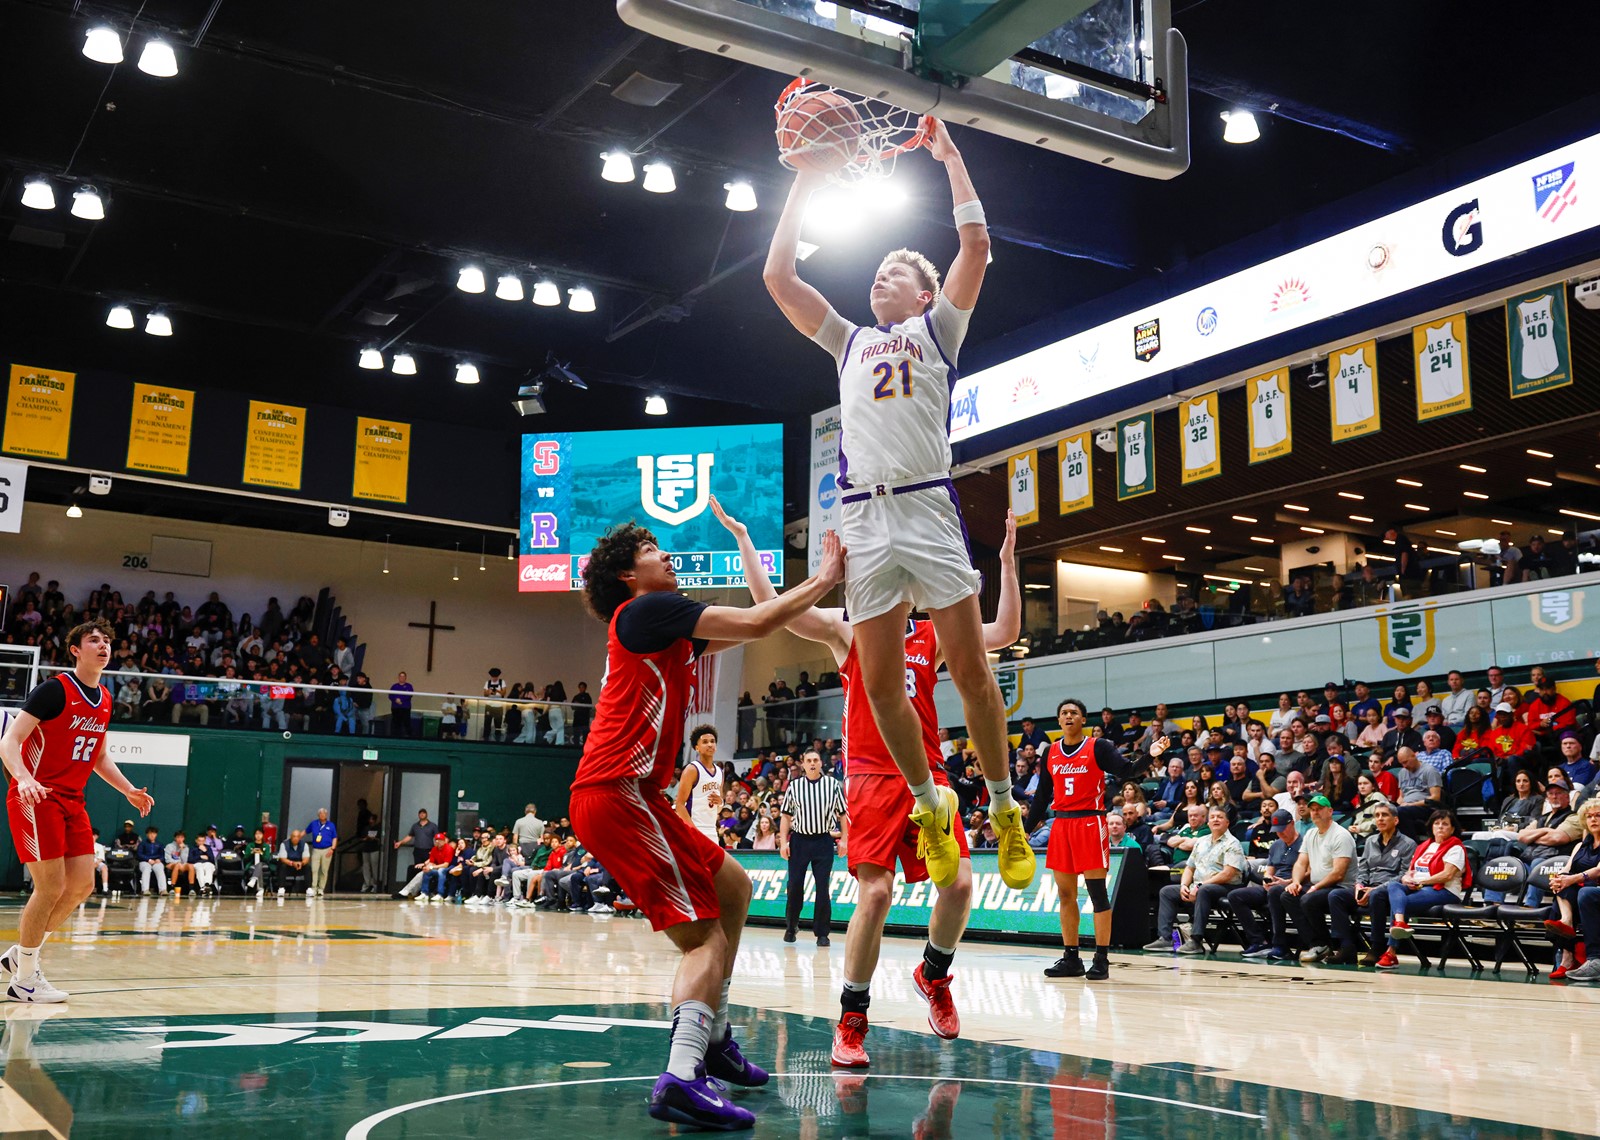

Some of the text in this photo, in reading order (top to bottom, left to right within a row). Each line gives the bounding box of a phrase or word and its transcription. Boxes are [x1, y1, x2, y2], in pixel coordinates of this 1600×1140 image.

[1442, 198, 1483, 257] G
[1525, 310, 1549, 325] U.S.F.
[1136, 325, 1158, 340] ARMY
[1527, 322, 1547, 340] 40
[1428, 338, 1454, 354] U.S.F.
[1430, 352, 1452, 373] 24
[1341, 364, 1365, 379] U.S.F.
[19, 376, 65, 391] FRANCISCO
[873, 359, 913, 402] 21
[1348, 378, 1358, 394] 4
[21, 395, 59, 406] NATIONAL
[142, 395, 185, 409] FRANCISCO
[1258, 389, 1279, 404] U.S.F.
[16, 403, 62, 413] CHAMPIONS
[1265, 404, 1273, 419] 6
[137, 418, 186, 430] TOURNAMENT
[257, 412, 297, 425] FRANCISCO
[1189, 414, 1209, 427] U.S.F.
[253, 429, 298, 440] CONFERENCE
[365, 428, 403, 441] FRANCISCO
[815, 419, 842, 439] FRANCISC
[1191, 426, 1208, 443] 32
[255, 436, 296, 446] CHAMPIONS
[1127, 432, 1143, 443] U.S.F.
[27, 448, 60, 456] BASKETBALL
[363, 451, 401, 461] CHAMPIONS
[1067, 451, 1084, 462] U.S.F.
[1130, 443, 1140, 456] 15
[813, 455, 840, 469] BASKETBA
[1016, 468, 1031, 479] U.S.F.
[1068, 462, 1082, 478] 20
[876, 485, 887, 496] R
[1018, 479, 1028, 492] 31
[530, 513, 559, 548] R
[122, 555, 148, 569] 206
[695, 563, 701, 571] 2
[520, 564, 569, 582] Coca-Cola
[72, 736, 98, 762] 22
[1052, 763, 1088, 775] Wildcats
[702, 781, 719, 793] RIOR
[1064, 777, 1074, 796] 5
[1485, 866, 1517, 876] FRANCISCO
[1540, 866, 1563, 875] FRANC
